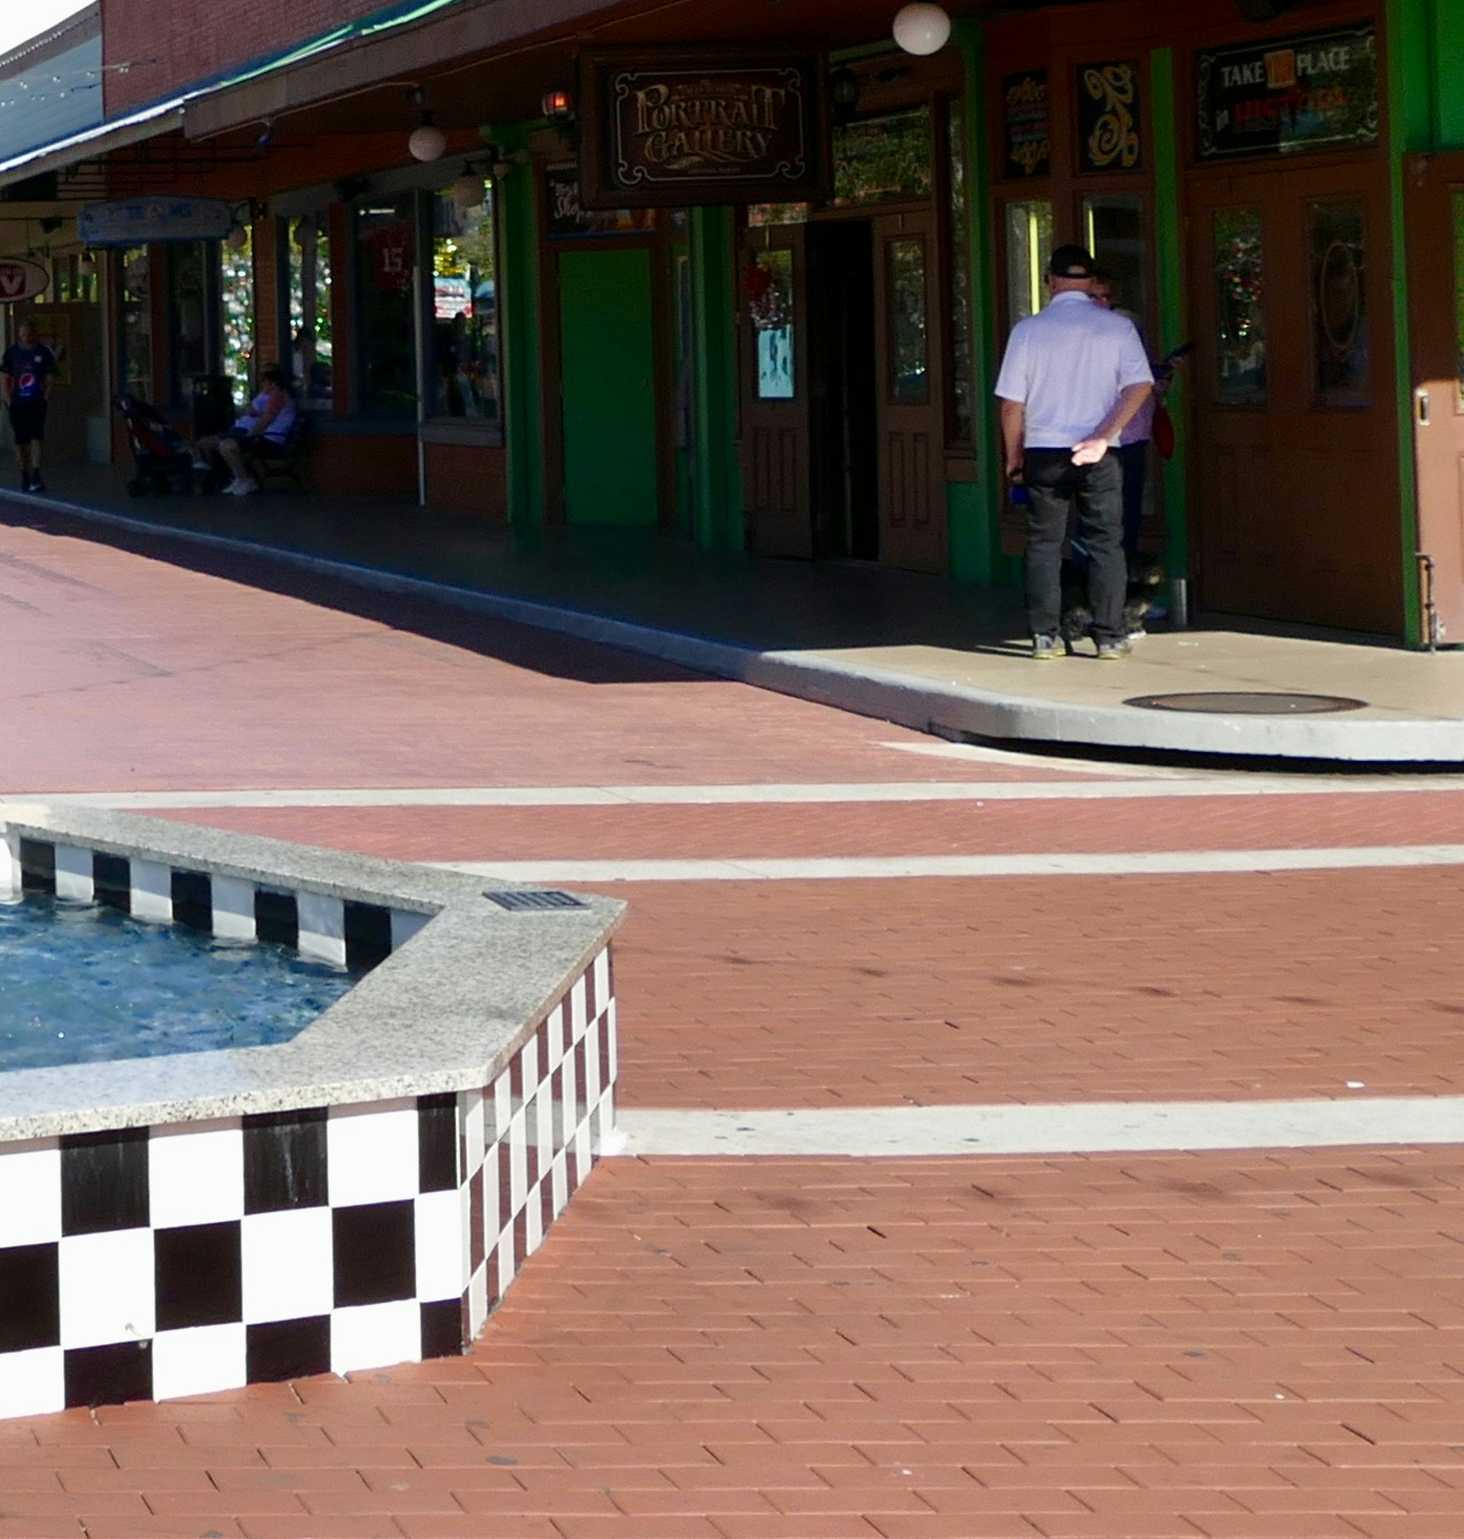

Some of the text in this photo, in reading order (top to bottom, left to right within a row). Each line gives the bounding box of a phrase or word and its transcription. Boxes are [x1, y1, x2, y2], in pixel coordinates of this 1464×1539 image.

[1221, 61, 1267, 89] TAKE
[1296, 46, 1351, 78] PLACE
[635, 83, 786, 136] PORTRAIT
[644, 124, 776, 165] GALLERY
